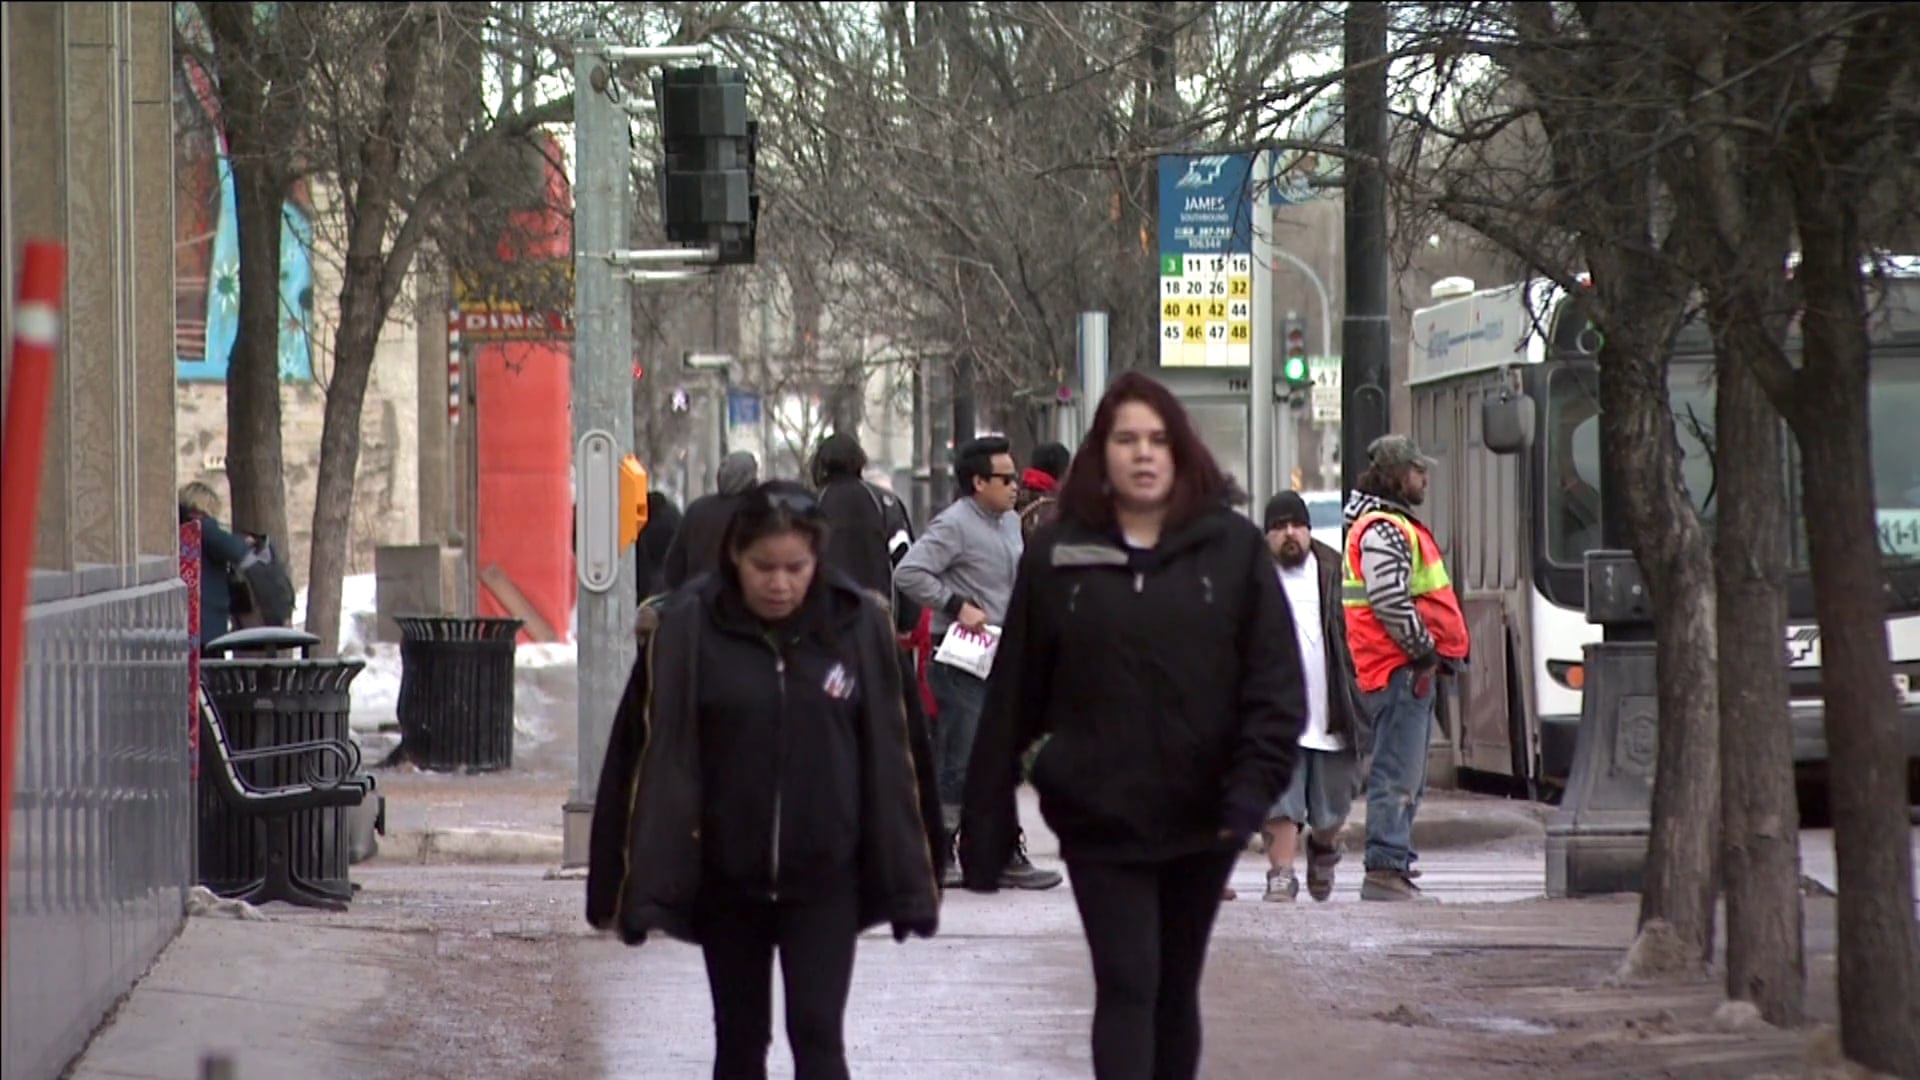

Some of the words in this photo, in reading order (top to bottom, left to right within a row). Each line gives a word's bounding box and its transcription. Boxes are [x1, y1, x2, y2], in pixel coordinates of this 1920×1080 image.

[1184, 195, 1226, 212] JAMES
[1168, 258, 1177, 273] 3
[1188, 259, 1201, 272] 11
[1210, 259, 1225, 272] 15
[1233, 259, 1248, 272] 16
[1166, 280, 1180, 295] 18
[1187, 280, 1202, 295] 20
[1209, 280, 1225, 295] 26
[1231, 280, 1247, 295] 32
[1164, 303, 1180, 317] 40
[1187, 303, 1201, 317] 41
[1208, 303, 1224, 317] 42
[1231, 303, 1247, 317] 44
[1164, 325, 1180, 340] 45
[1187, 325, 1202, 340] 46
[1209, 325, 1225, 340] 47
[1231, 325, 1247, 340] 48
